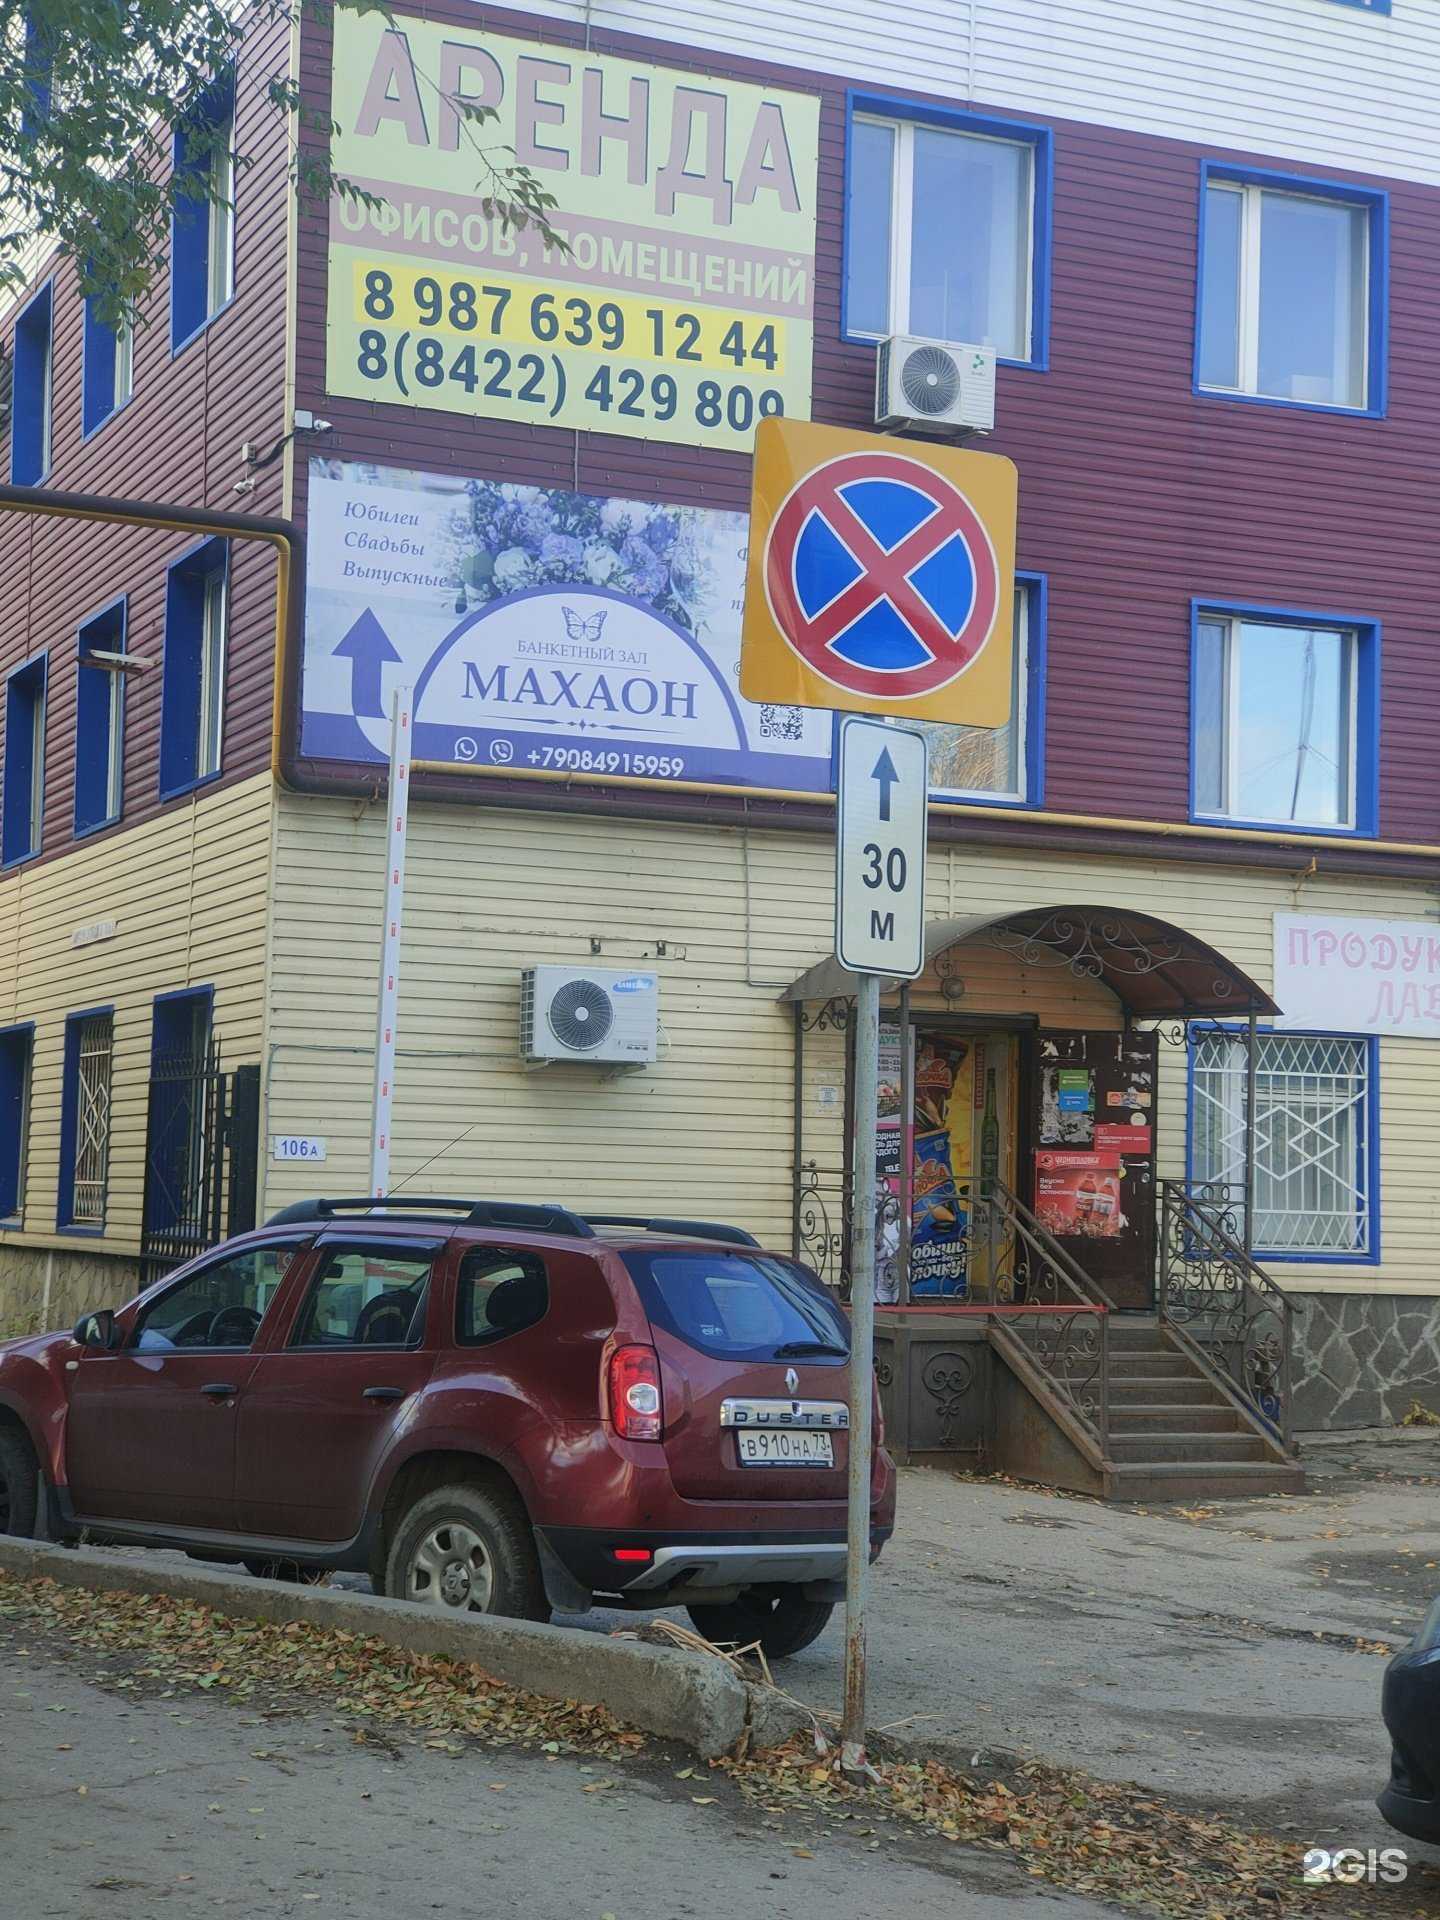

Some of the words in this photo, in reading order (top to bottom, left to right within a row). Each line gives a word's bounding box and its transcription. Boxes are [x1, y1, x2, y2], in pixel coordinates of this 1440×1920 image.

[354, 28, 801, 226] АРЕНДА
[339, 197, 528, 267] ОФИСОВ,
[364, 270, 394, 320] 8
[413, 277, 512, 336] 987
[530, 293, 625, 351] 639
[646, 309, 703, 361] 12
[719, 320, 779, 370] 44
[358, 329, 567, 418] 8(8422)
[585, 365, 677, 421] 429
[695, 380, 784, 432] 809
[344, 502, 419, 526] Юбилеи
[344, 531, 425, 556] Свадьбы
[343, 560, 448, 588] Выпускные
[518, 639, 614, 662] БАНКЕТНЫЙ
[619, 649, 648, 665] ЗАЛ
[461, 661, 698, 719] МАХАОН
[527, 746, 684, 777] +79084915959
[862, 843, 907, 893] 30
[734, 1411, 848, 1426] DUSTER
